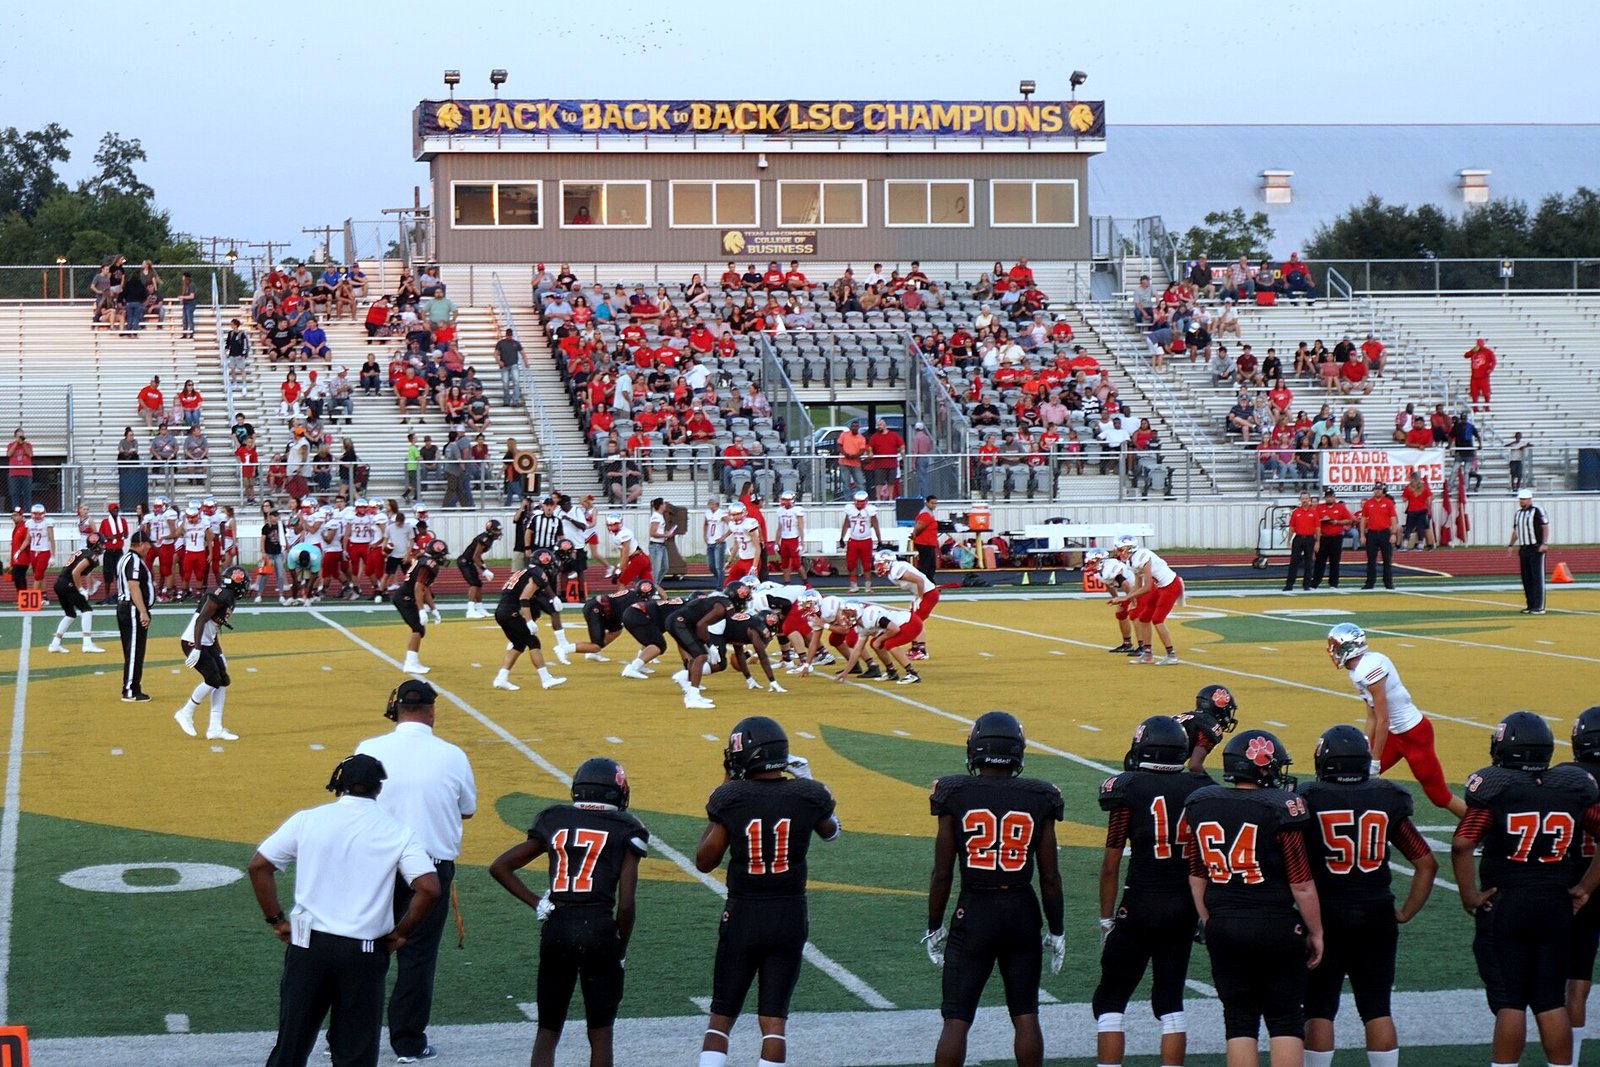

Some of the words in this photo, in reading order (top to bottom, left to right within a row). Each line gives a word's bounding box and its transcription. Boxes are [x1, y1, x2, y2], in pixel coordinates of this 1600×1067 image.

[470, 103, 559, 130] BACK
[561, 110, 577, 123] to
[581, 103, 671, 130] BACK
[673, 110, 689, 123] to
[691, 103, 780, 130] BACK
[787, 103, 855, 131] LSC
[863, 103, 1063, 132] CHAMPIONS
[747, 244, 814, 254] BUSINESS
[1328, 451, 1389, 465] MEADOR
[527, 473, 536, 492] 1
[850, 520, 866, 534] 75
[190, 532, 198, 547] 4
[20, 592, 39, 610] 30
[1285, 797, 1306, 817] 64
[745, 818, 792, 875] 11
[962, 808, 1035, 872] 28
[1317, 809, 1389, 875] 50
[1507, 811, 1575, 863] 73
[552, 828, 609, 893] 17
[1196, 821, 1265, 884] 64
[956, 908, 965, 919] C
[1118, 907, 1128, 919] C
